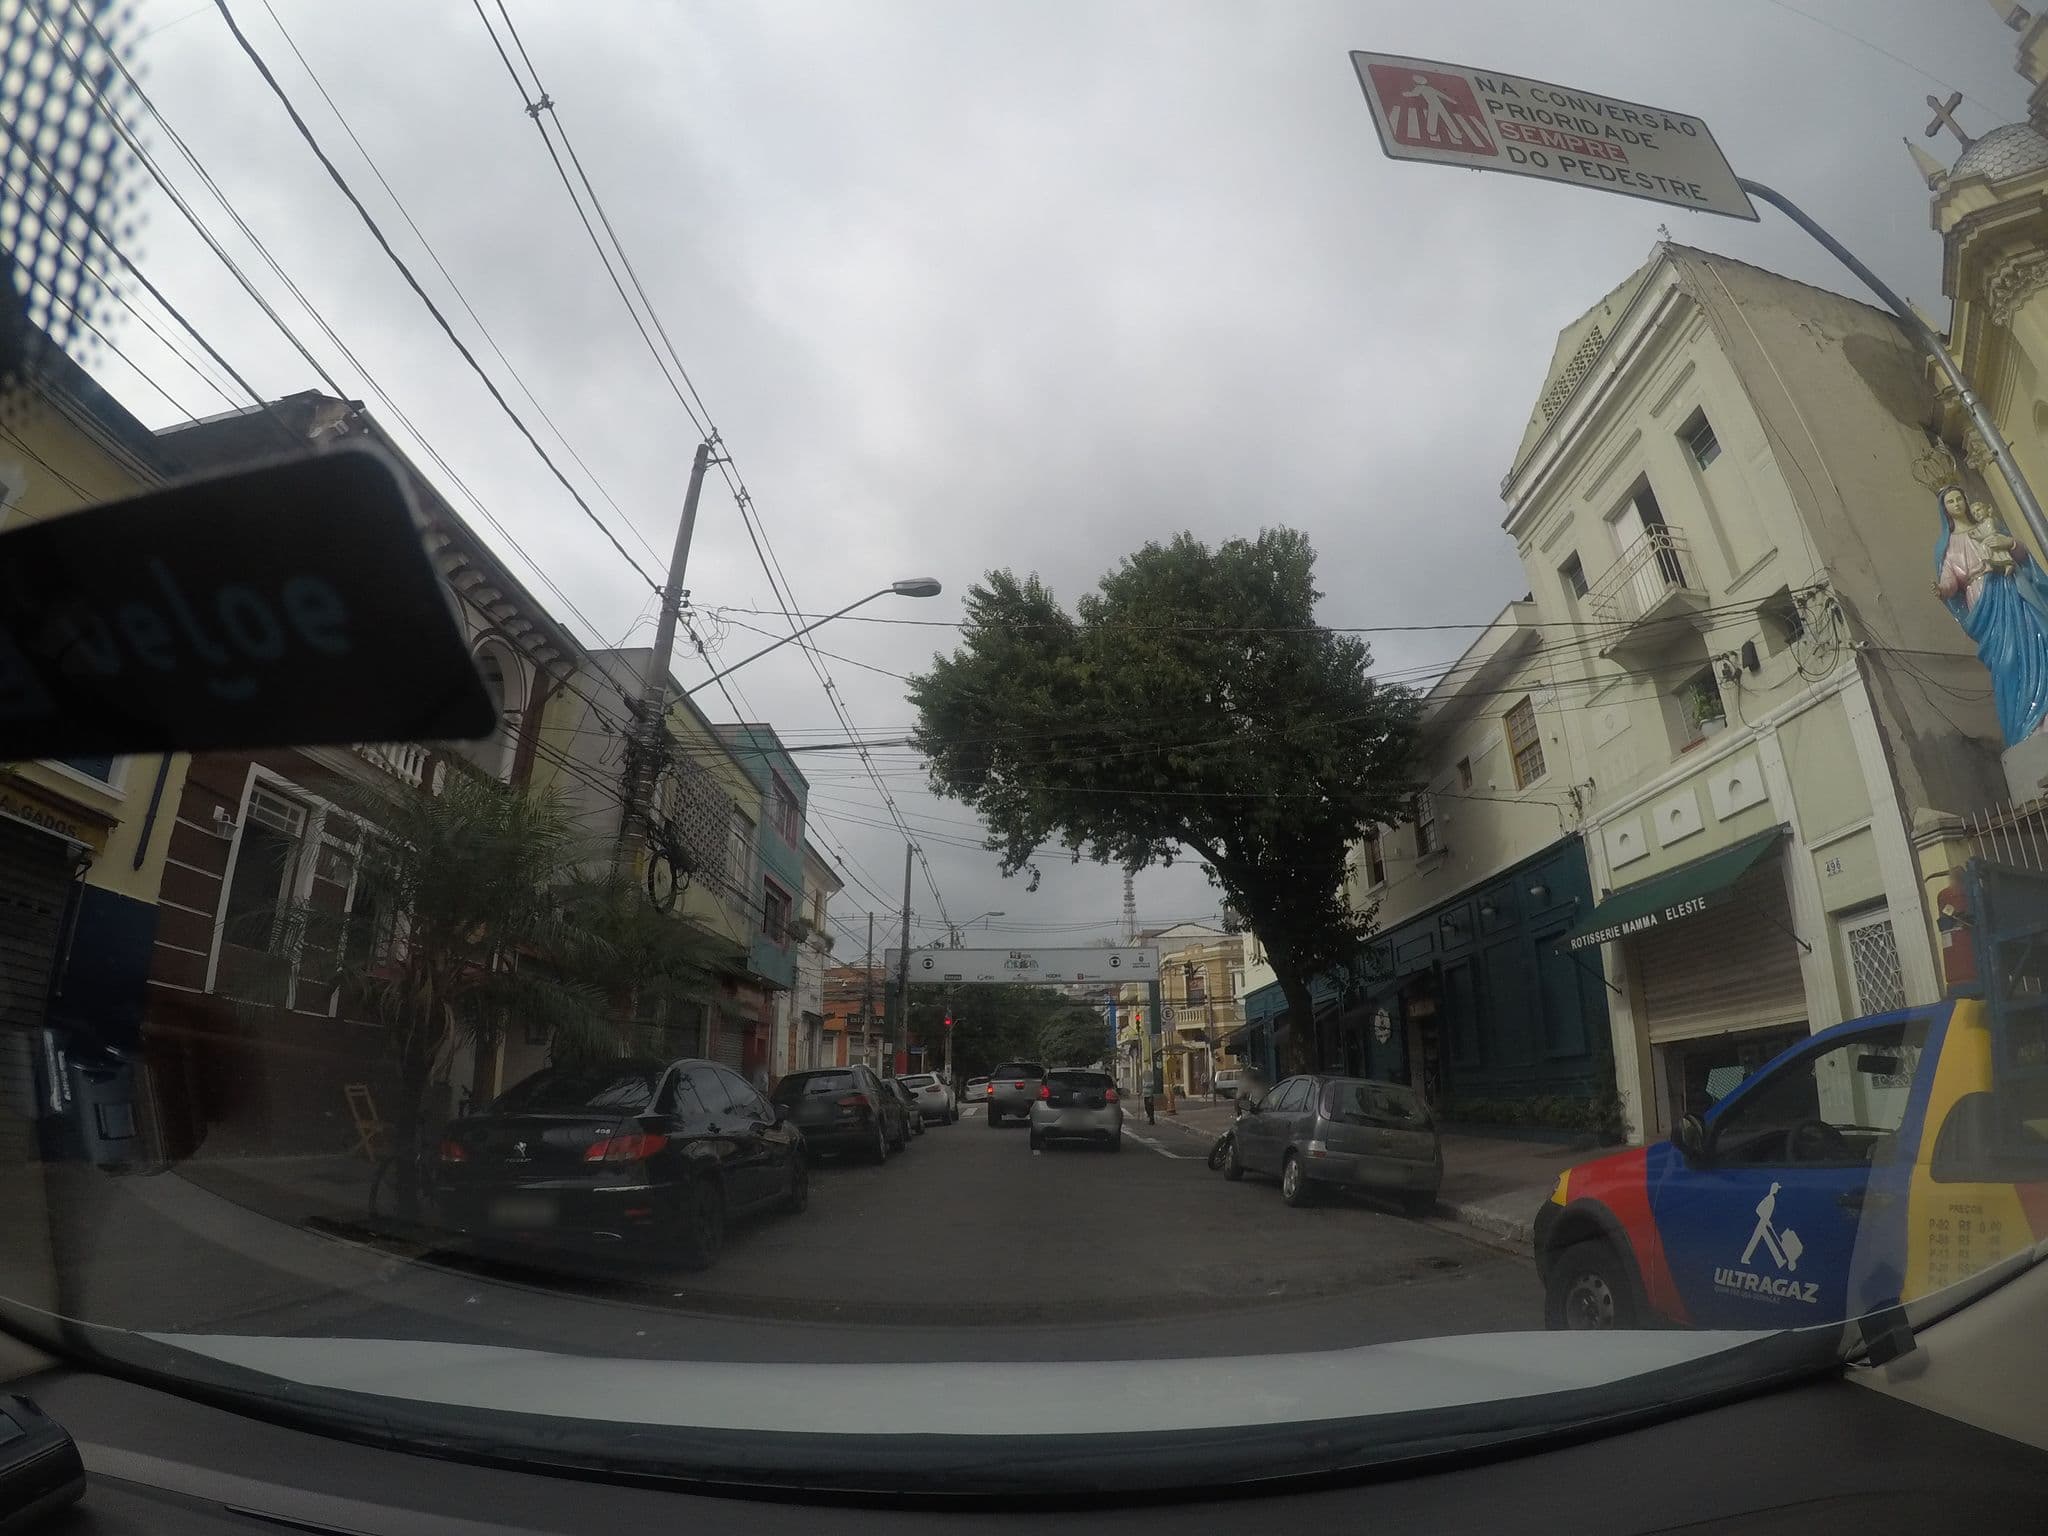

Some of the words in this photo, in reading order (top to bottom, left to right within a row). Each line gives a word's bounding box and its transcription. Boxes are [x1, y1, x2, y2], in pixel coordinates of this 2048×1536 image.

[1476, 76, 1520, 98] NA
[1531, 87, 1698, 139] CONVERSÃO
[1487, 99, 1660, 151] PRIORIDADE
[1499, 122, 1627, 163] SEMPRE
[1507, 146, 1550, 170] DO
[1559, 155, 1709, 202] PEDESTRE
[1570, 924, 1621, 950] ROTISSERIE
[1622, 913, 1658, 935] MAMMA
[1664, 896, 1707, 921] ELESTE
[1713, 1266, 1820, 1305] ULTRAGAZ
